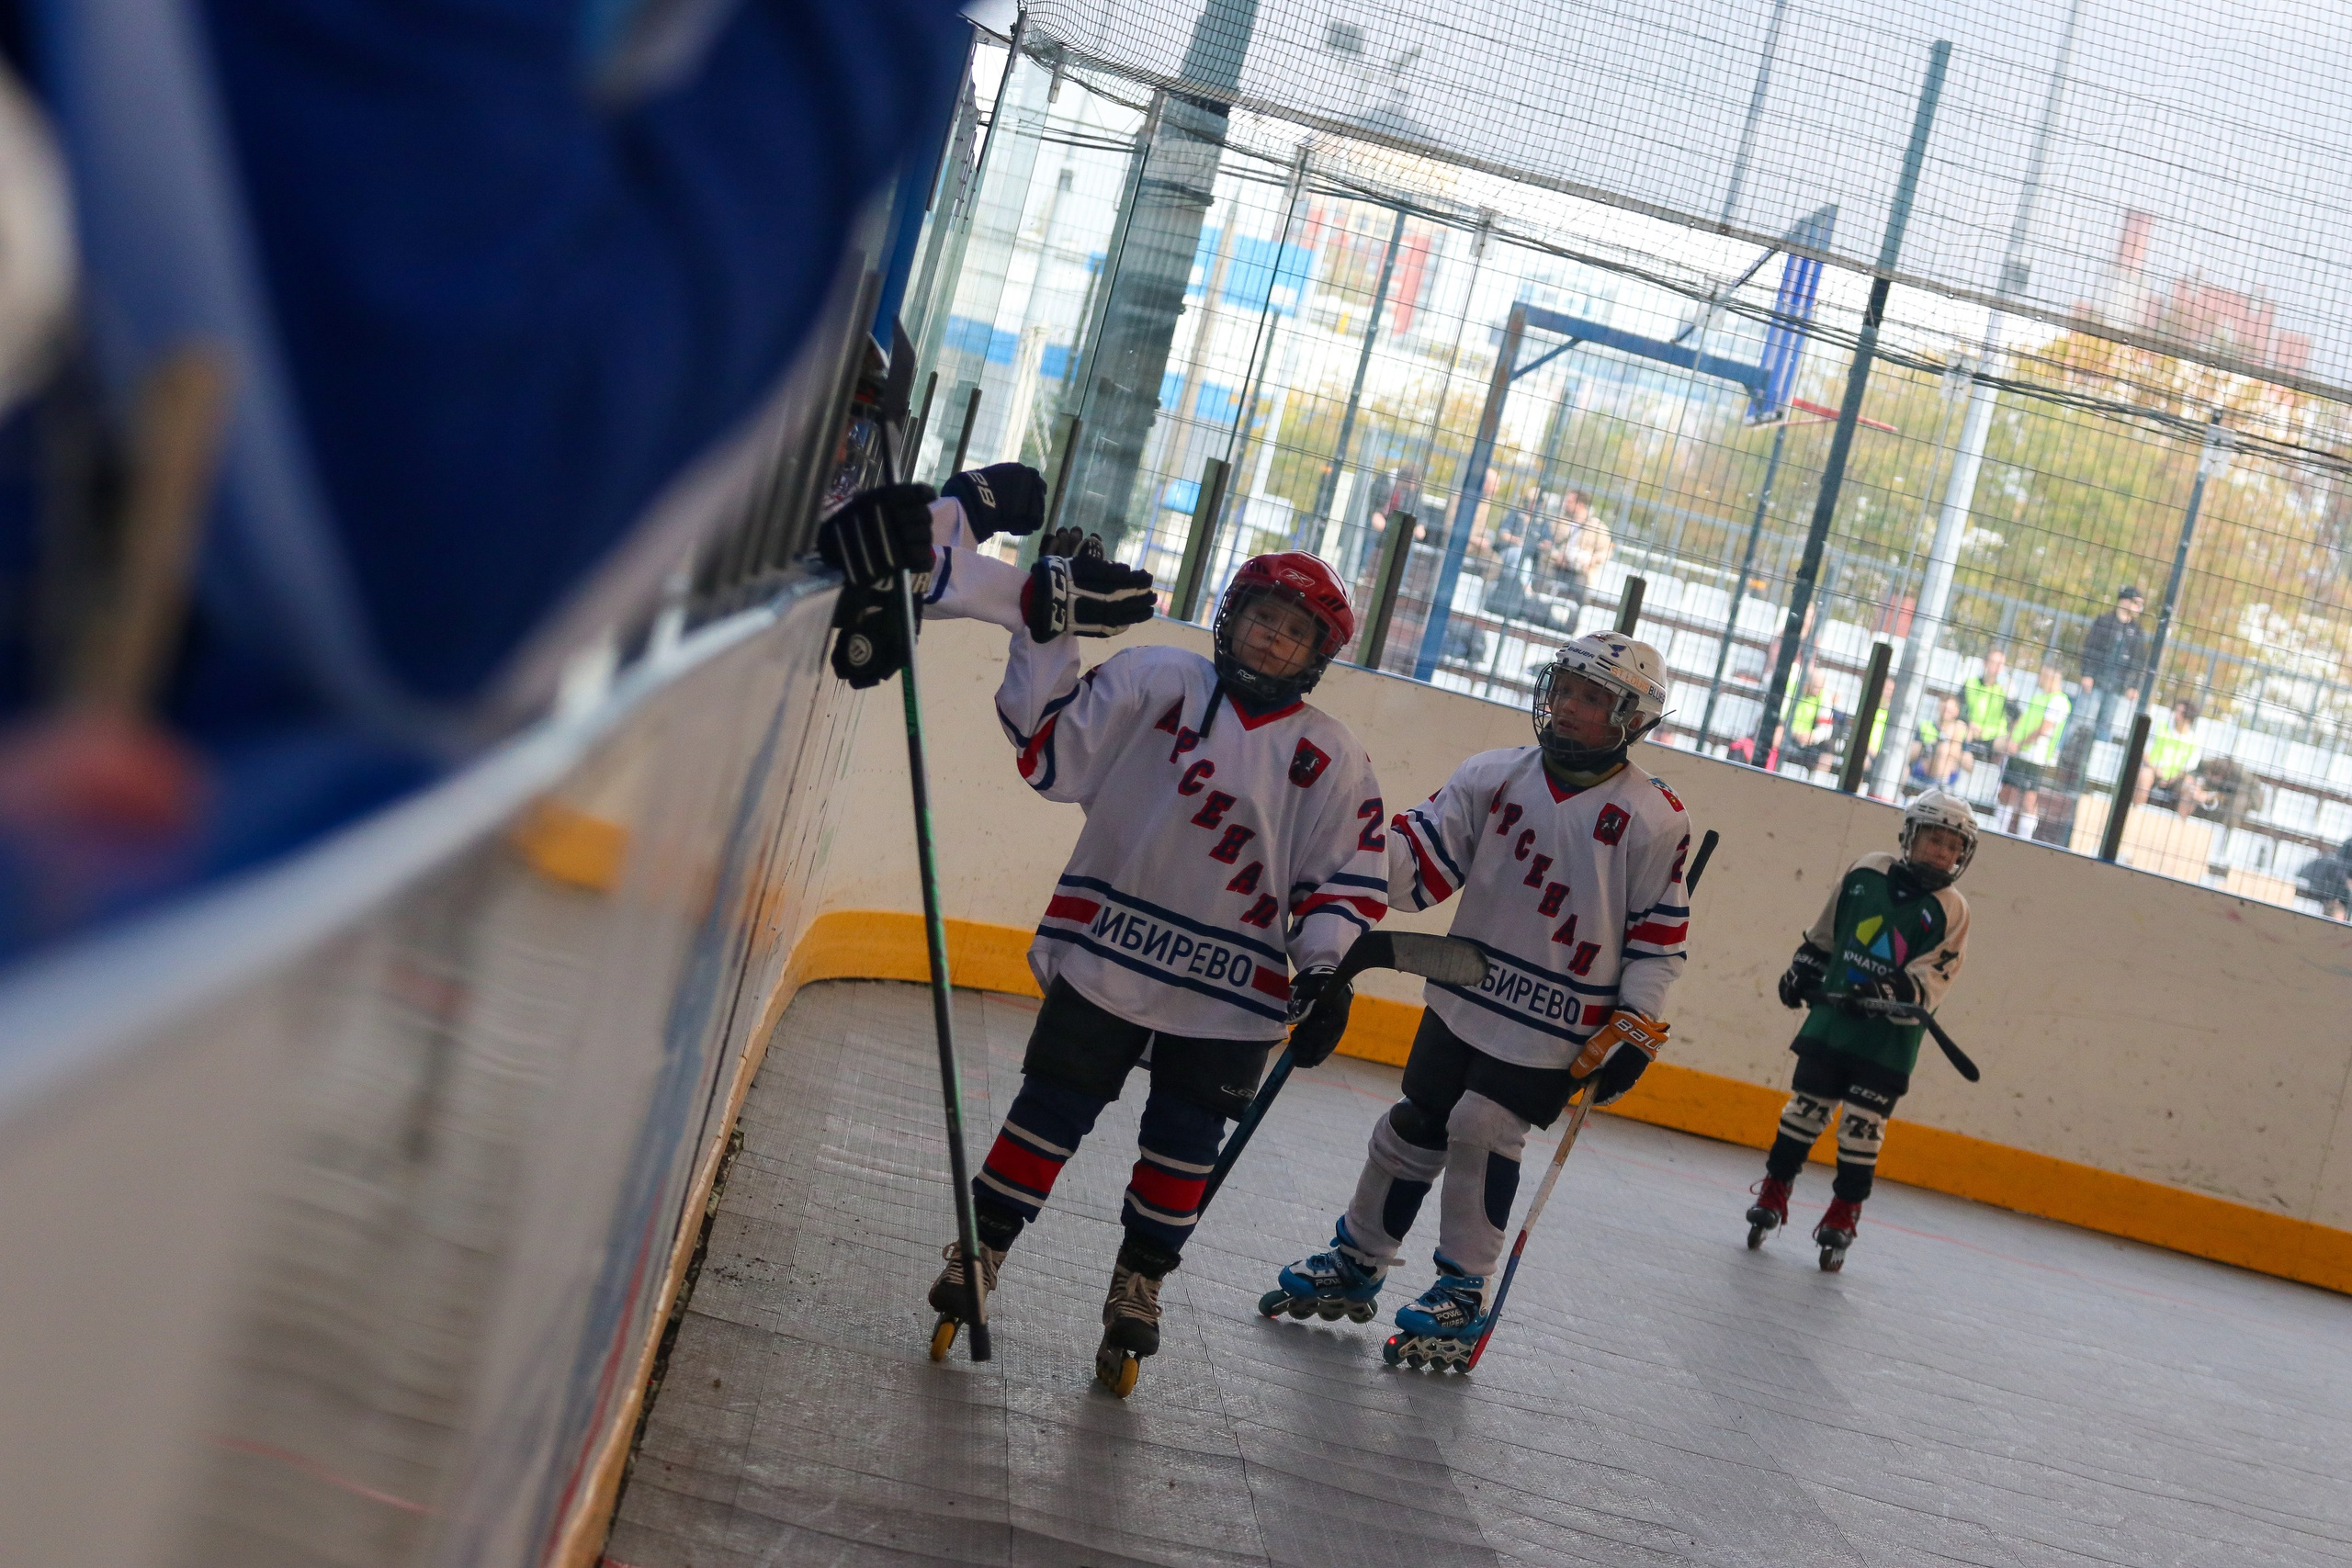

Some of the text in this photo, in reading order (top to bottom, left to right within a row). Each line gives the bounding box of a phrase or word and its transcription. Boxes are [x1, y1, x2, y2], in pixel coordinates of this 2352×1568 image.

[1091, 906, 1253, 987] ИБИРЕВО
[1479, 963, 1581, 1025] БИРЕВО
[1614, 1018, 1662, 1052] BAU
[1845, 1113, 1881, 1141] 71
[1315, 1278, 1341, 1287] POW
[1435, 1309, 1463, 1321] POWE
